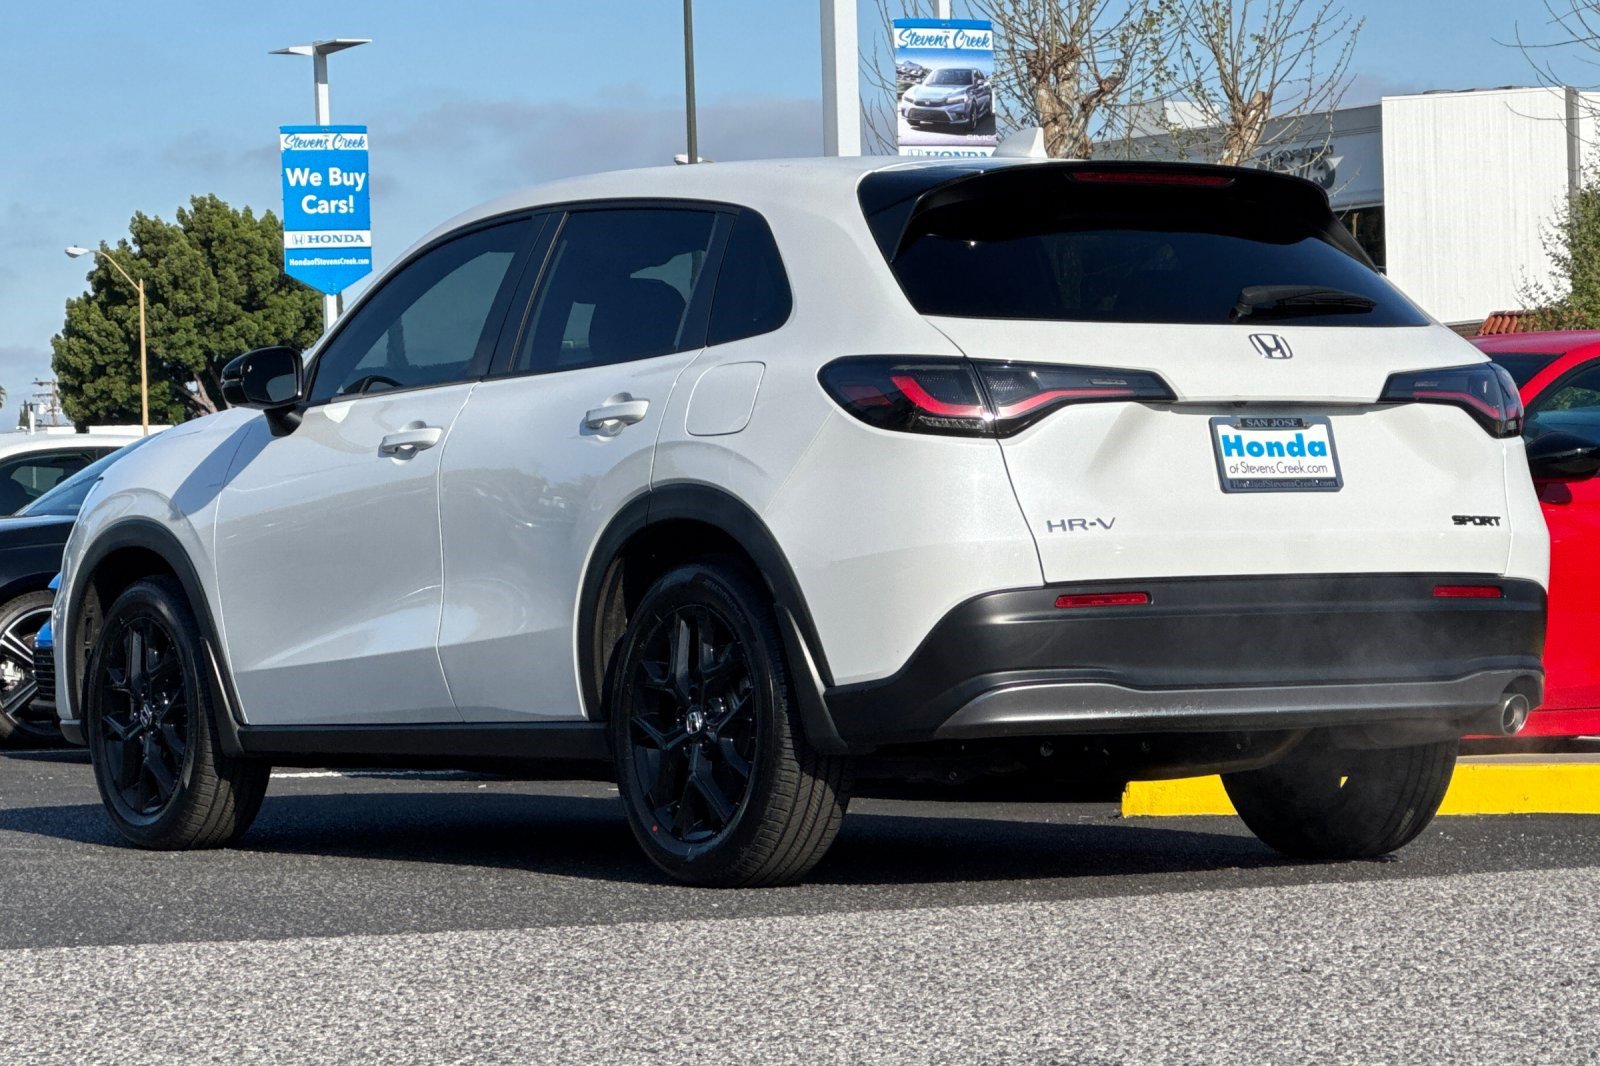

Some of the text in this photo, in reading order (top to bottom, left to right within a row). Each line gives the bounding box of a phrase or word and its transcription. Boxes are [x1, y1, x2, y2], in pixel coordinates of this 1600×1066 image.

[898, 28, 990, 49] Stevens Creek
[284, 133, 365, 150] Stevens Creek
[285, 167, 366, 192] We Buy
[301, 195, 354, 214] Cars!
[308, 234, 365, 243] HONDA
[289, 258, 369, 266] HondaofStevensCreek.com
[1246, 419, 1298, 427] SAN JOSE
[1221, 433, 1327, 457] Honda
[1240, 461, 1276, 474] Stevens
[1277, 461, 1328, 474] Creek.com
[1046, 517, 1116, 533] HR-V
[1451, 515, 1501, 526] SPORT
